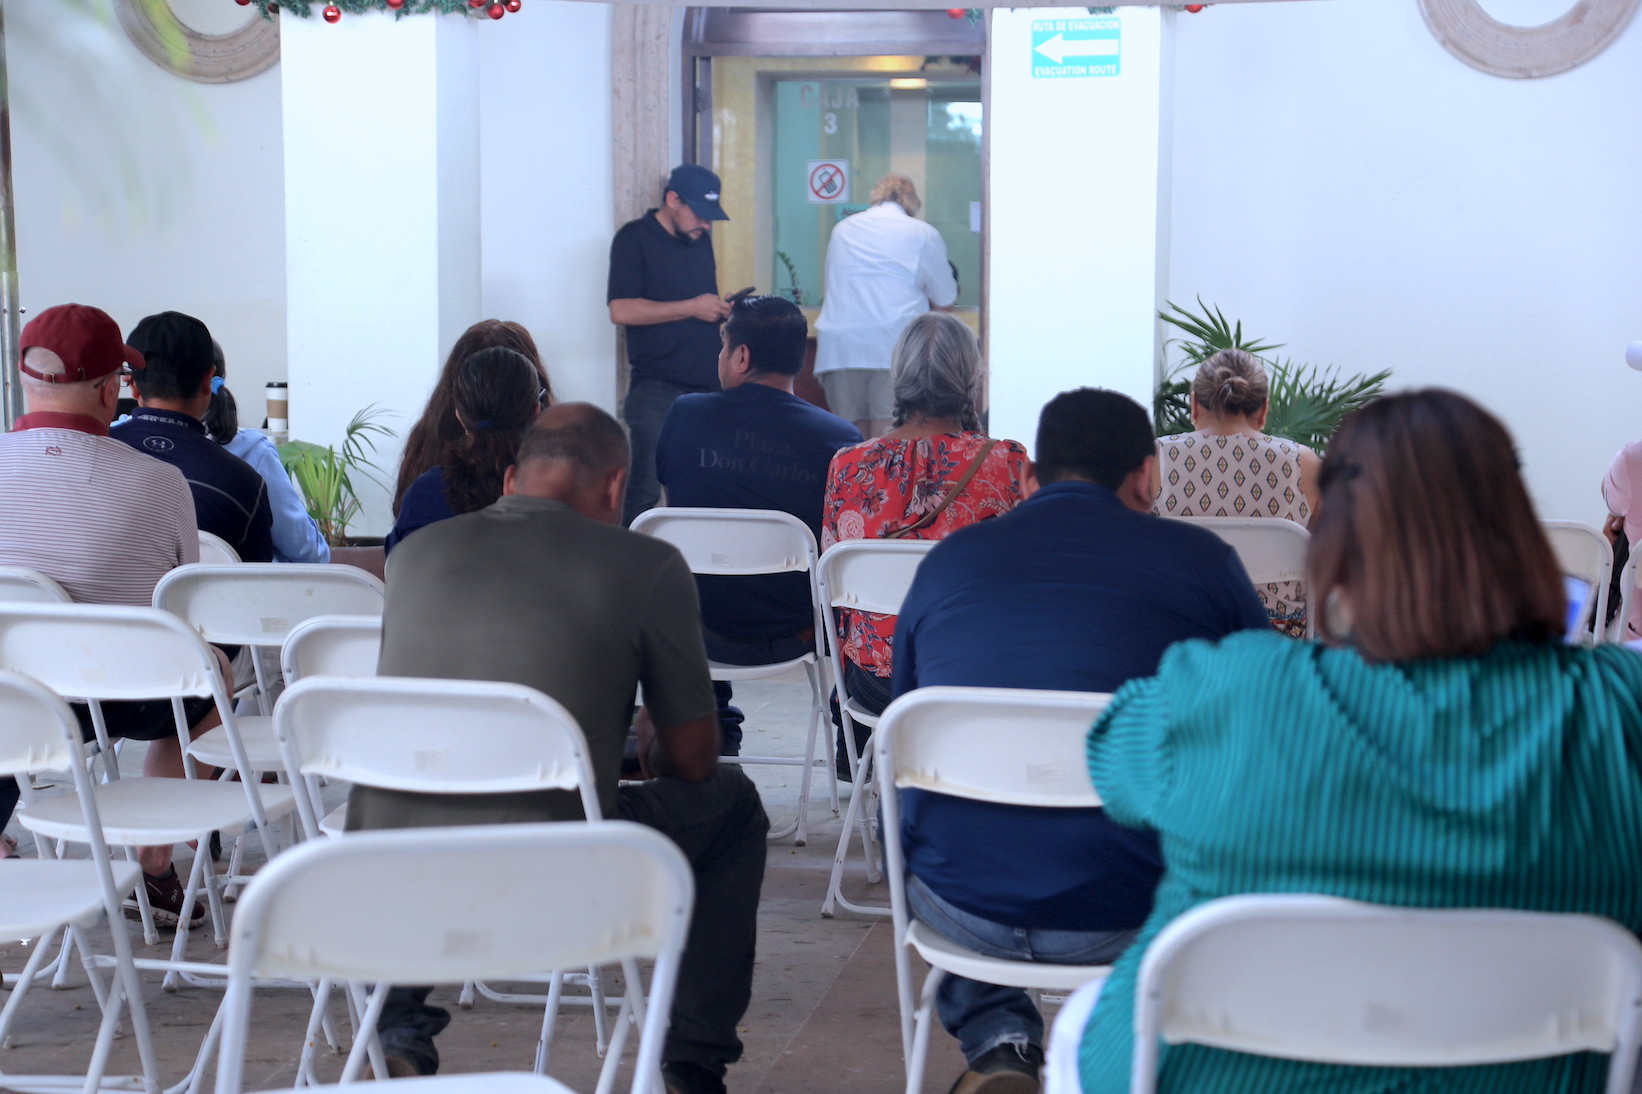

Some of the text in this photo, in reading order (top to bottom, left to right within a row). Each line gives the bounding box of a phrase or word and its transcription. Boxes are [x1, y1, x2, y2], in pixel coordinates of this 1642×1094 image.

[1055, 21, 1067, 31] DE
[1034, 64, 1117, 76] EVACUATION ROUTE
[800, 85, 860, 108] CAJA
[823, 112, 838, 135] 3
[699, 447, 819, 482] Don Carlos
